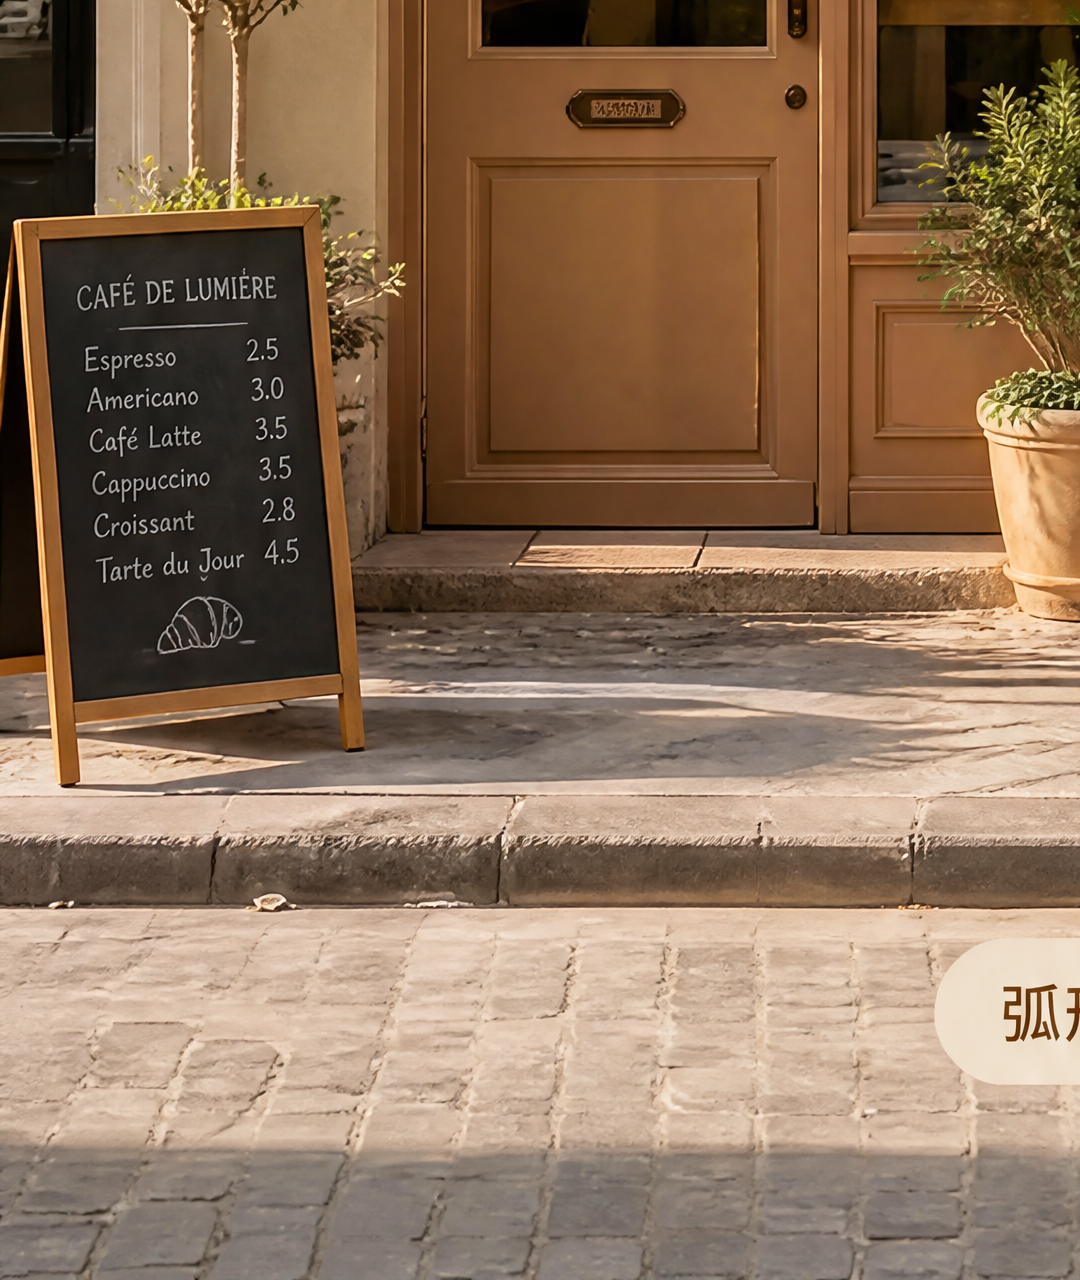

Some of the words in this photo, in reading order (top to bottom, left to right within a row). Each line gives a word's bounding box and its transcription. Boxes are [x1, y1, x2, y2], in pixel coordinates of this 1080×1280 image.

[76, 273, 136, 311] CAFÉ
[145, 278, 175, 305] DE
[84, 345, 177, 380] Espresso
[246, 337, 279, 362] 2.5
[86, 387, 200, 414] Americano
[251, 376, 285, 402] 3.0
[89, 425, 139, 458] Café
[149, 424, 202, 449] Latte
[255, 415, 288, 441] 3.5
[92, 467, 211, 503] Cappuccino
[258, 455, 292, 482] 3.5
[94, 510, 195, 538] Croissant
[262, 496, 296, 523] 2.8
[96, 555, 154, 584] Tarte
[162, 551, 190, 576] du
[198, 547, 245, 582] Jour
[264, 537, 300, 566] 4.5
